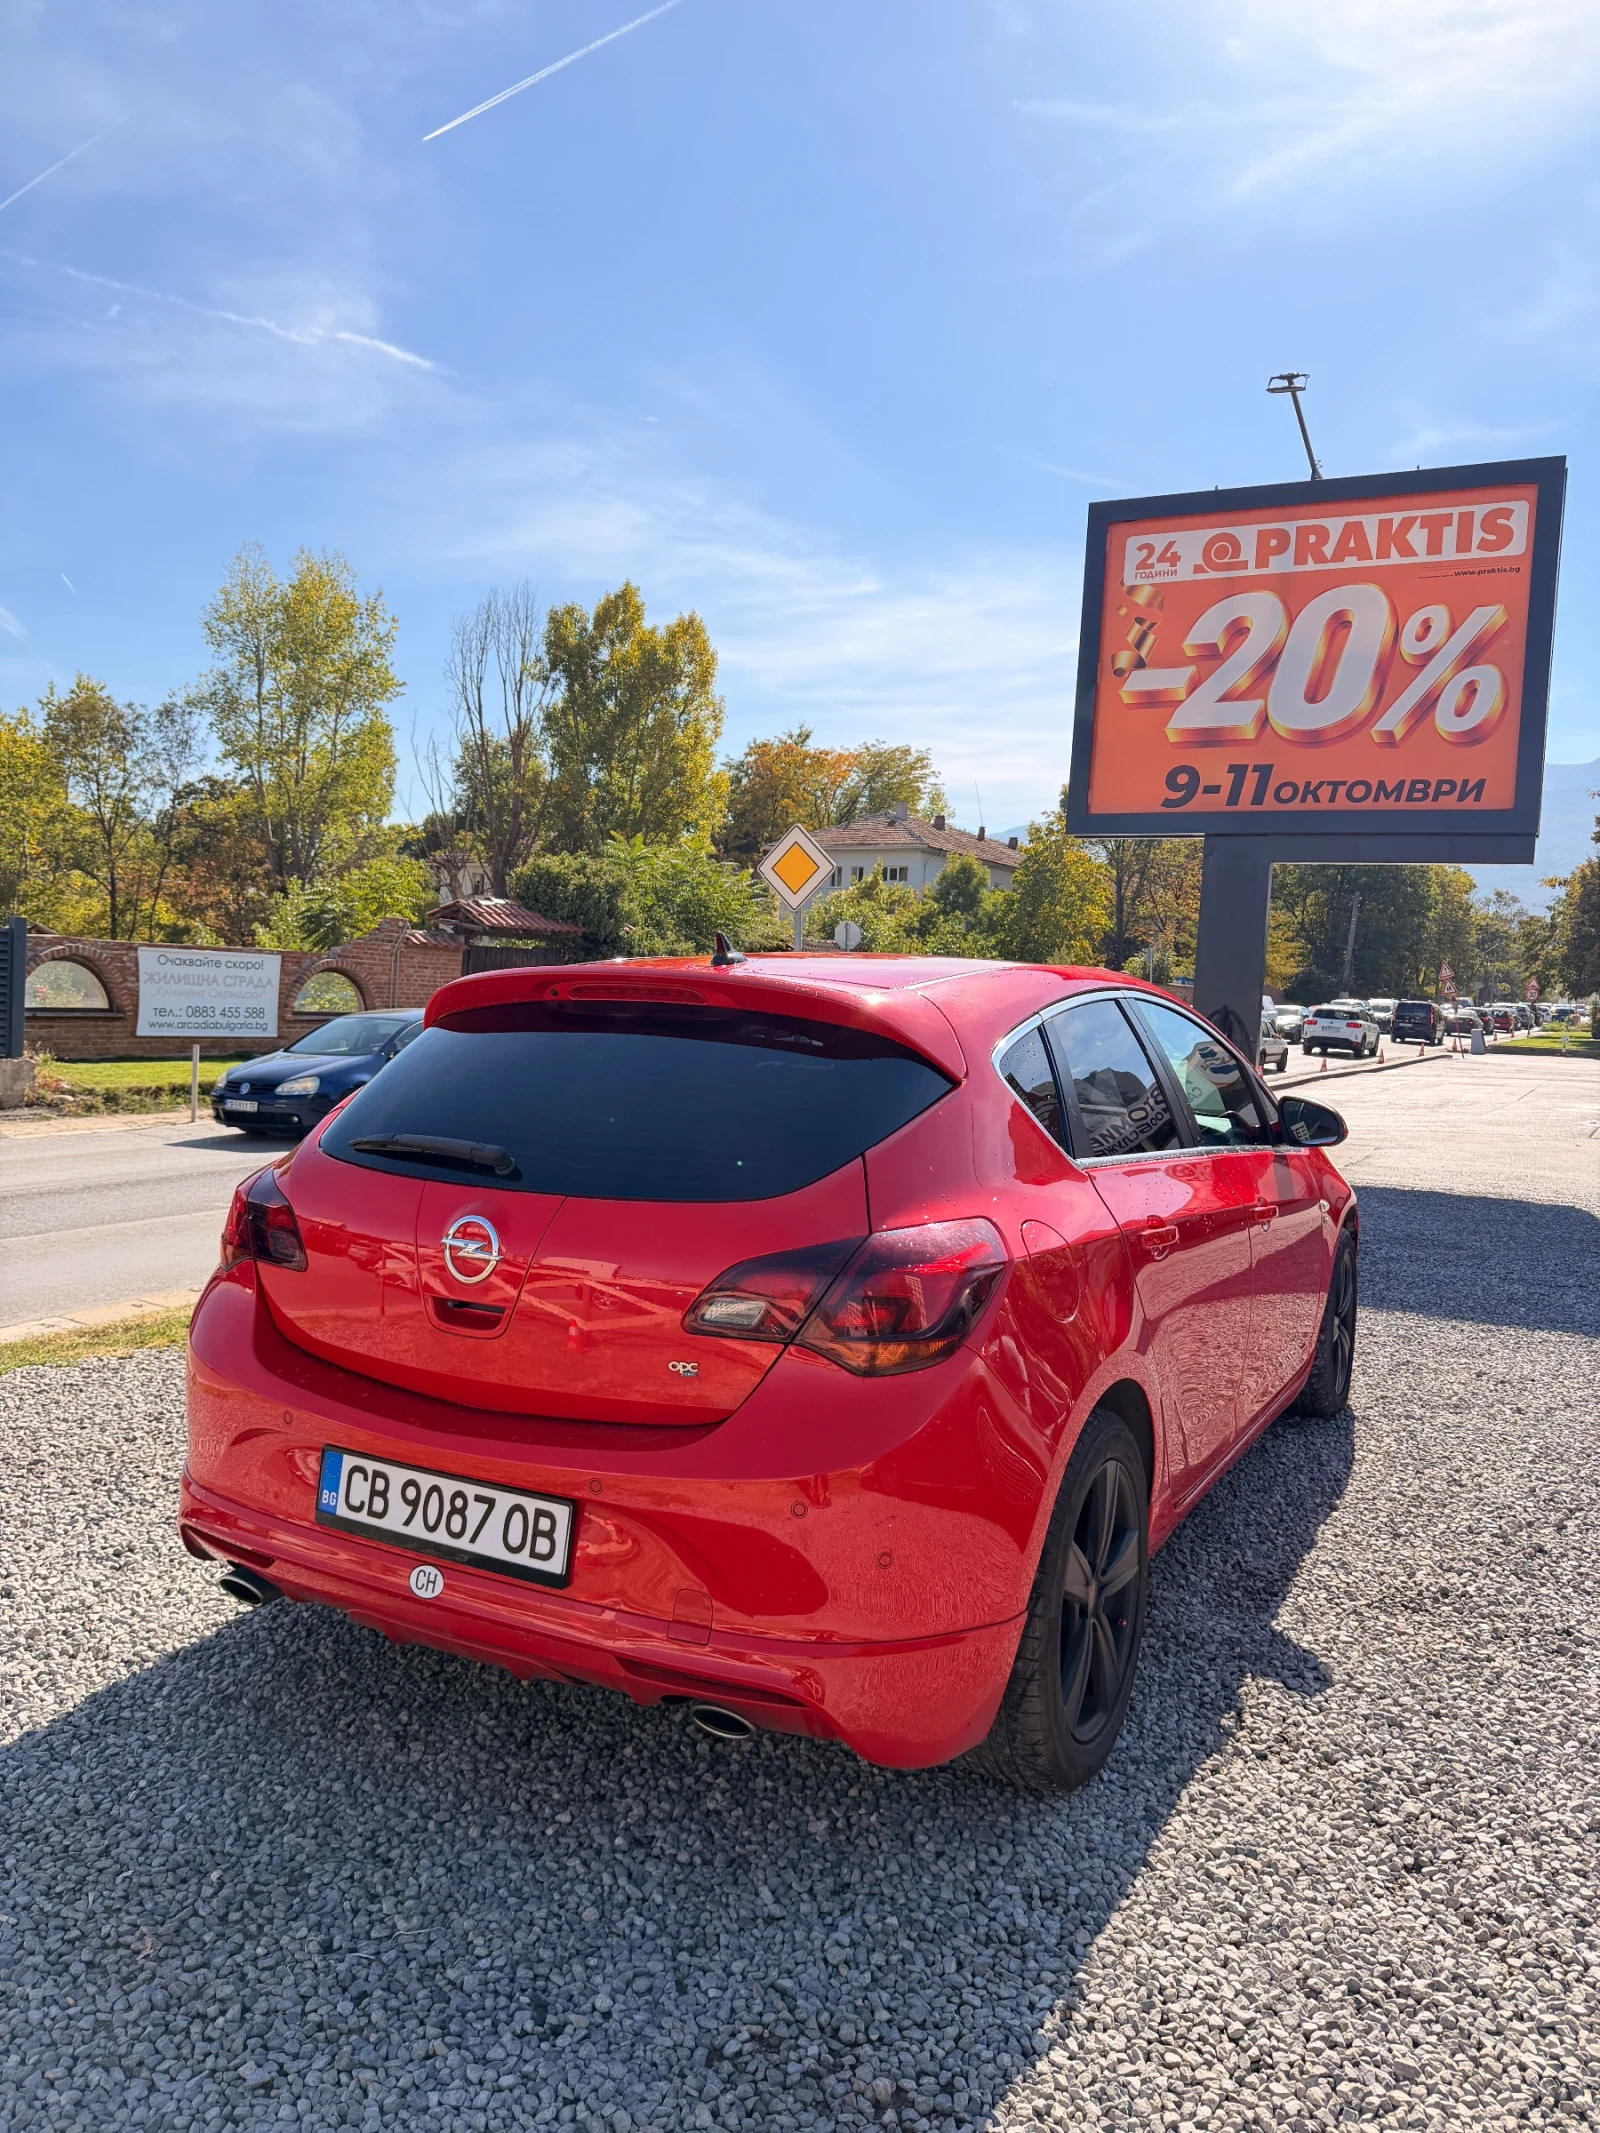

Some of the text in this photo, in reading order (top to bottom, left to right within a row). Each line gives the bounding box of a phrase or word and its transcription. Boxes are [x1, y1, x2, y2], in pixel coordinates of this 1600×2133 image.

[1254, 507, 1515, 570] PRAKTIS
[1135, 540, 1182, 571] 24
[1134, 568, 1178, 580] ГОДИНИ
[1454, 566, 1521, 576] www.praktis.bg
[1119, 583, 1512, 747] -20%
[1160, 763, 1487, 809] 9-11 ОКТОМВРИ
[157, 954, 264, 972] Очаквайте скоро!
[143, 971, 274, 989] ЖИЛИЩНА СГРАДА
[153, 1005, 266, 1019] тел.: 0883 455 588
[148, 1020, 268, 1032] www.arcadiabulgaria.bg
[322, 1489, 338, 1506] BG
[345, 1465, 557, 1561] CB 9087 OB
[415, 1569, 437, 1594] CH
